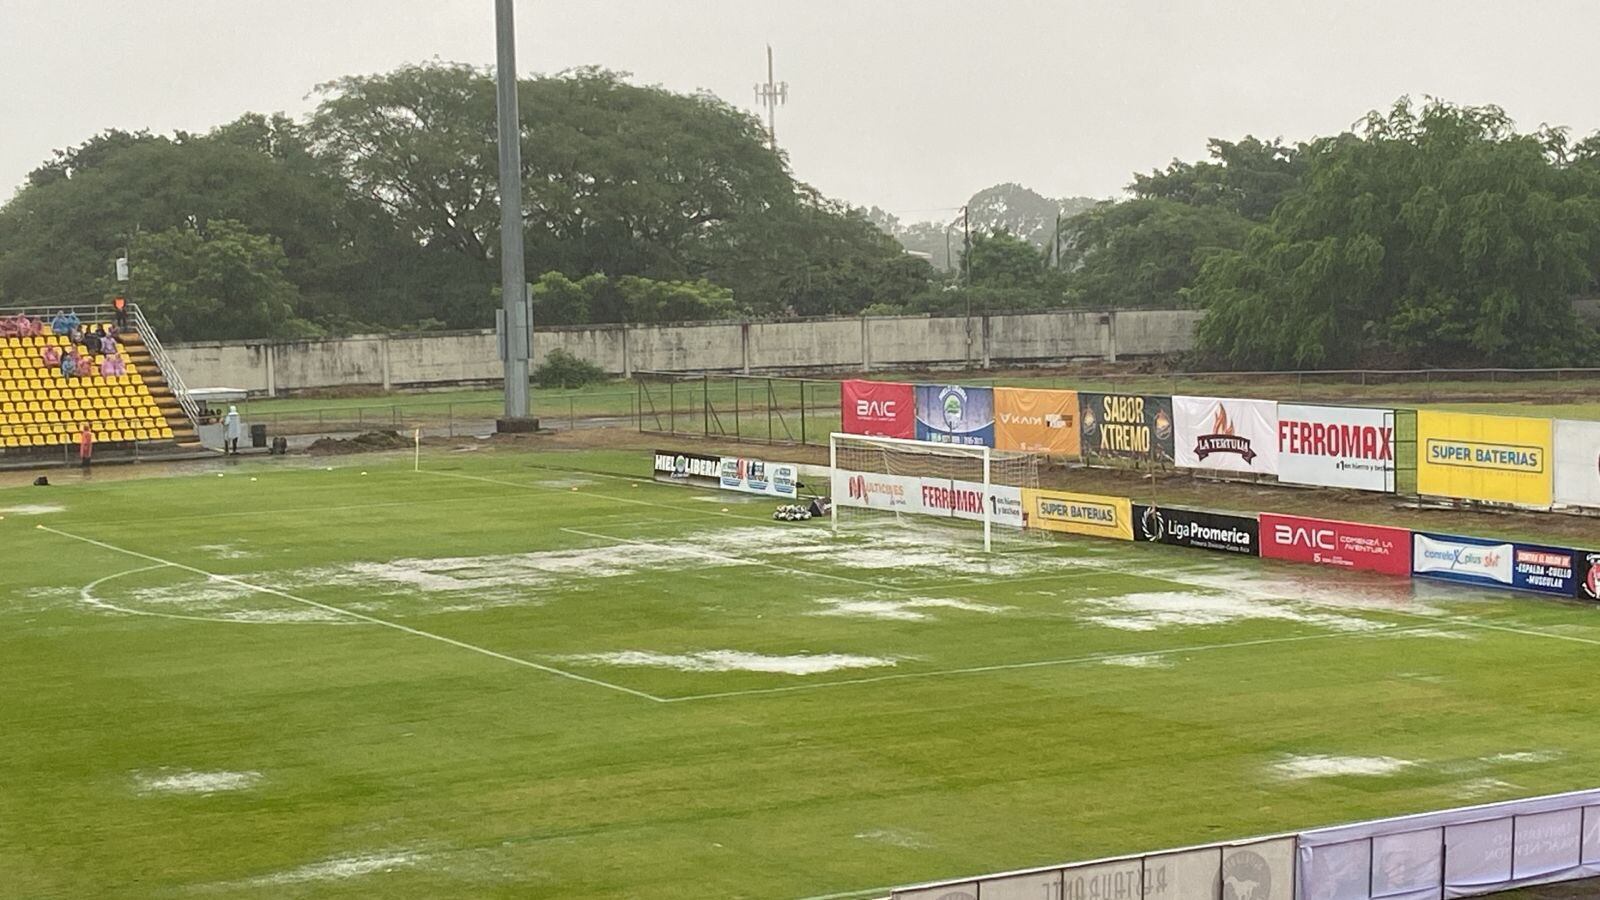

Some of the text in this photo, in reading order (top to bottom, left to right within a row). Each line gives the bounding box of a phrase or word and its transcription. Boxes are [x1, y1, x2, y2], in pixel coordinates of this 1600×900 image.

[857, 400, 897, 417] BAIC
[1103, 396, 1145, 424] SABOR
[1100, 424, 1150, 452] XTREMO
[1199, 438, 1249, 453] LA TERTULIA
[1279, 420, 1393, 461] FERROMAX
[655, 455, 676, 471] MIEL
[685, 457, 722, 477] LIBERIA
[1432, 445, 1538, 467] SUPER BATERIAS
[922, 485, 985, 514] FERROMAX
[1040, 502, 1113, 522] SUPER BATERIAS
[1168, 520, 1250, 545] Liga Promerica
[1275, 524, 1335, 550] BAIC
[1344, 543, 1389, 555] AVENTURA
[1382, 540, 1393, 548] LA
[1464, 552, 1481, 565] plus
